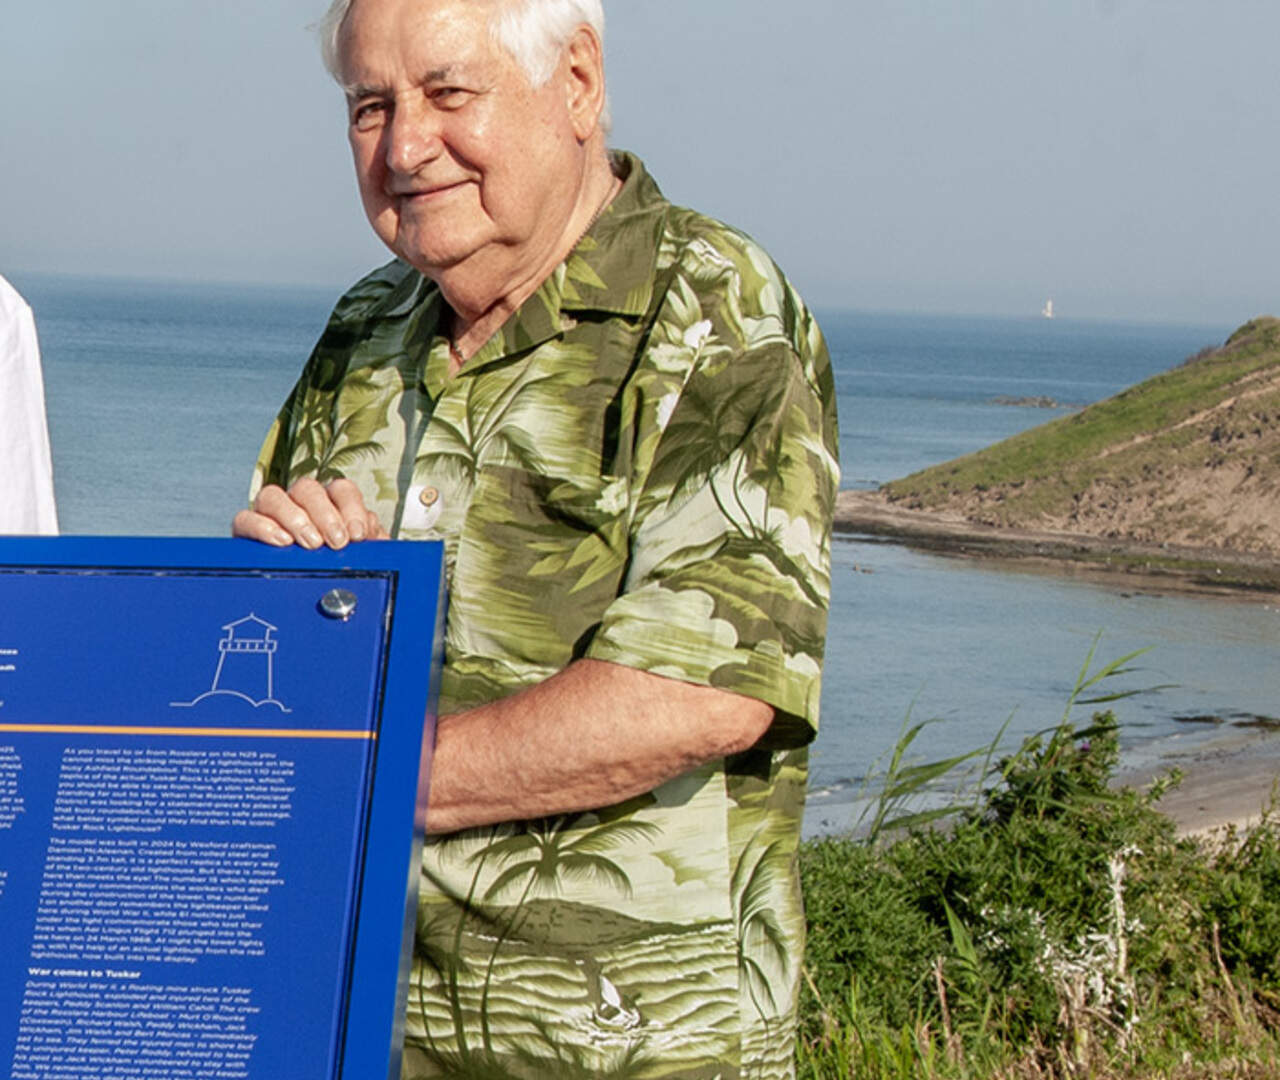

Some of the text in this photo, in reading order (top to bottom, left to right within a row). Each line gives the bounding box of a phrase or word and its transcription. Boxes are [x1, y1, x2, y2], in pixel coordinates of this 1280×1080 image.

[27, 967, 141, 979] War comes to Tuskar
